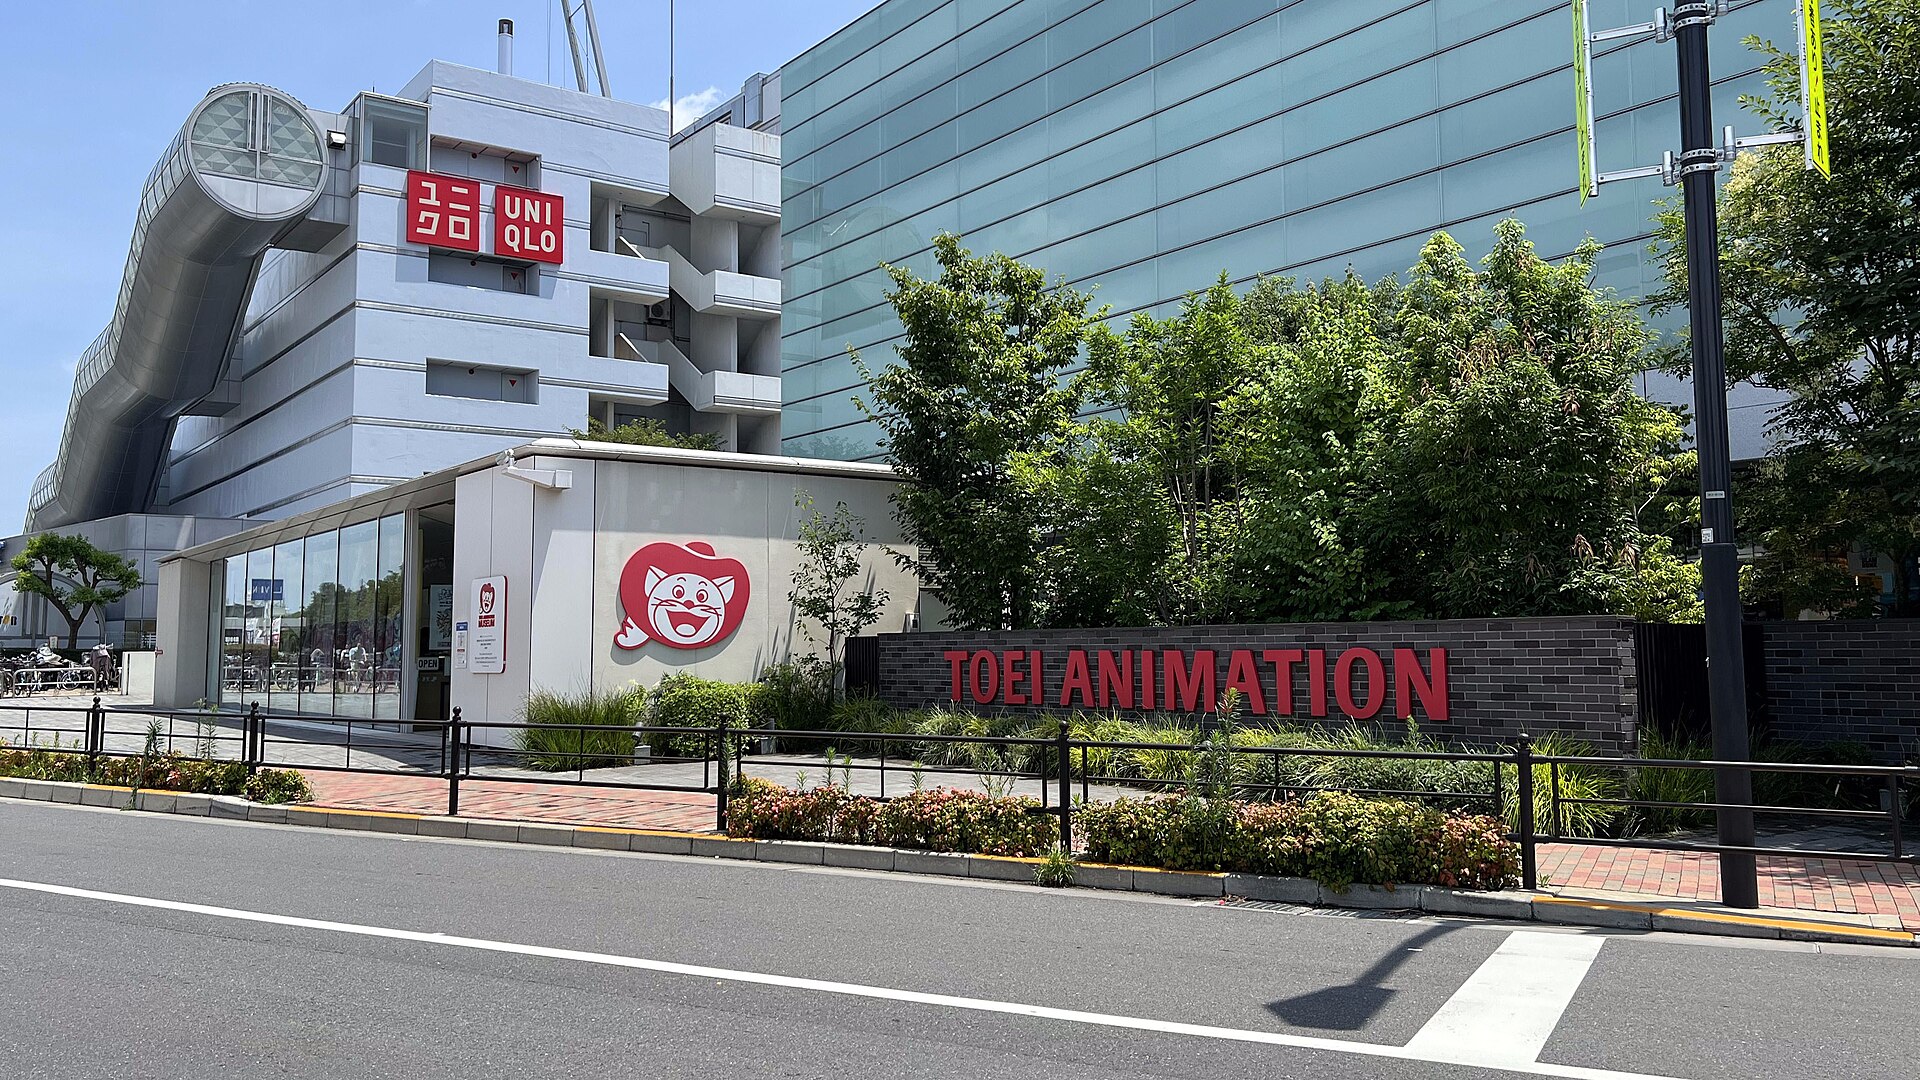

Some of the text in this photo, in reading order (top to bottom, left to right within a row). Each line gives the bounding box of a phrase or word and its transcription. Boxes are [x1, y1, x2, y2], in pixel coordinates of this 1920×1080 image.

[418, 181, 471, 212] ユニ
[504, 195, 552, 226] UNI
[416, 210, 471, 241] クロ
[504, 224, 556, 253] QLO
[418, 659, 438, 668] OPEN
[943, 647, 1450, 721] TOEI ANIMATION
